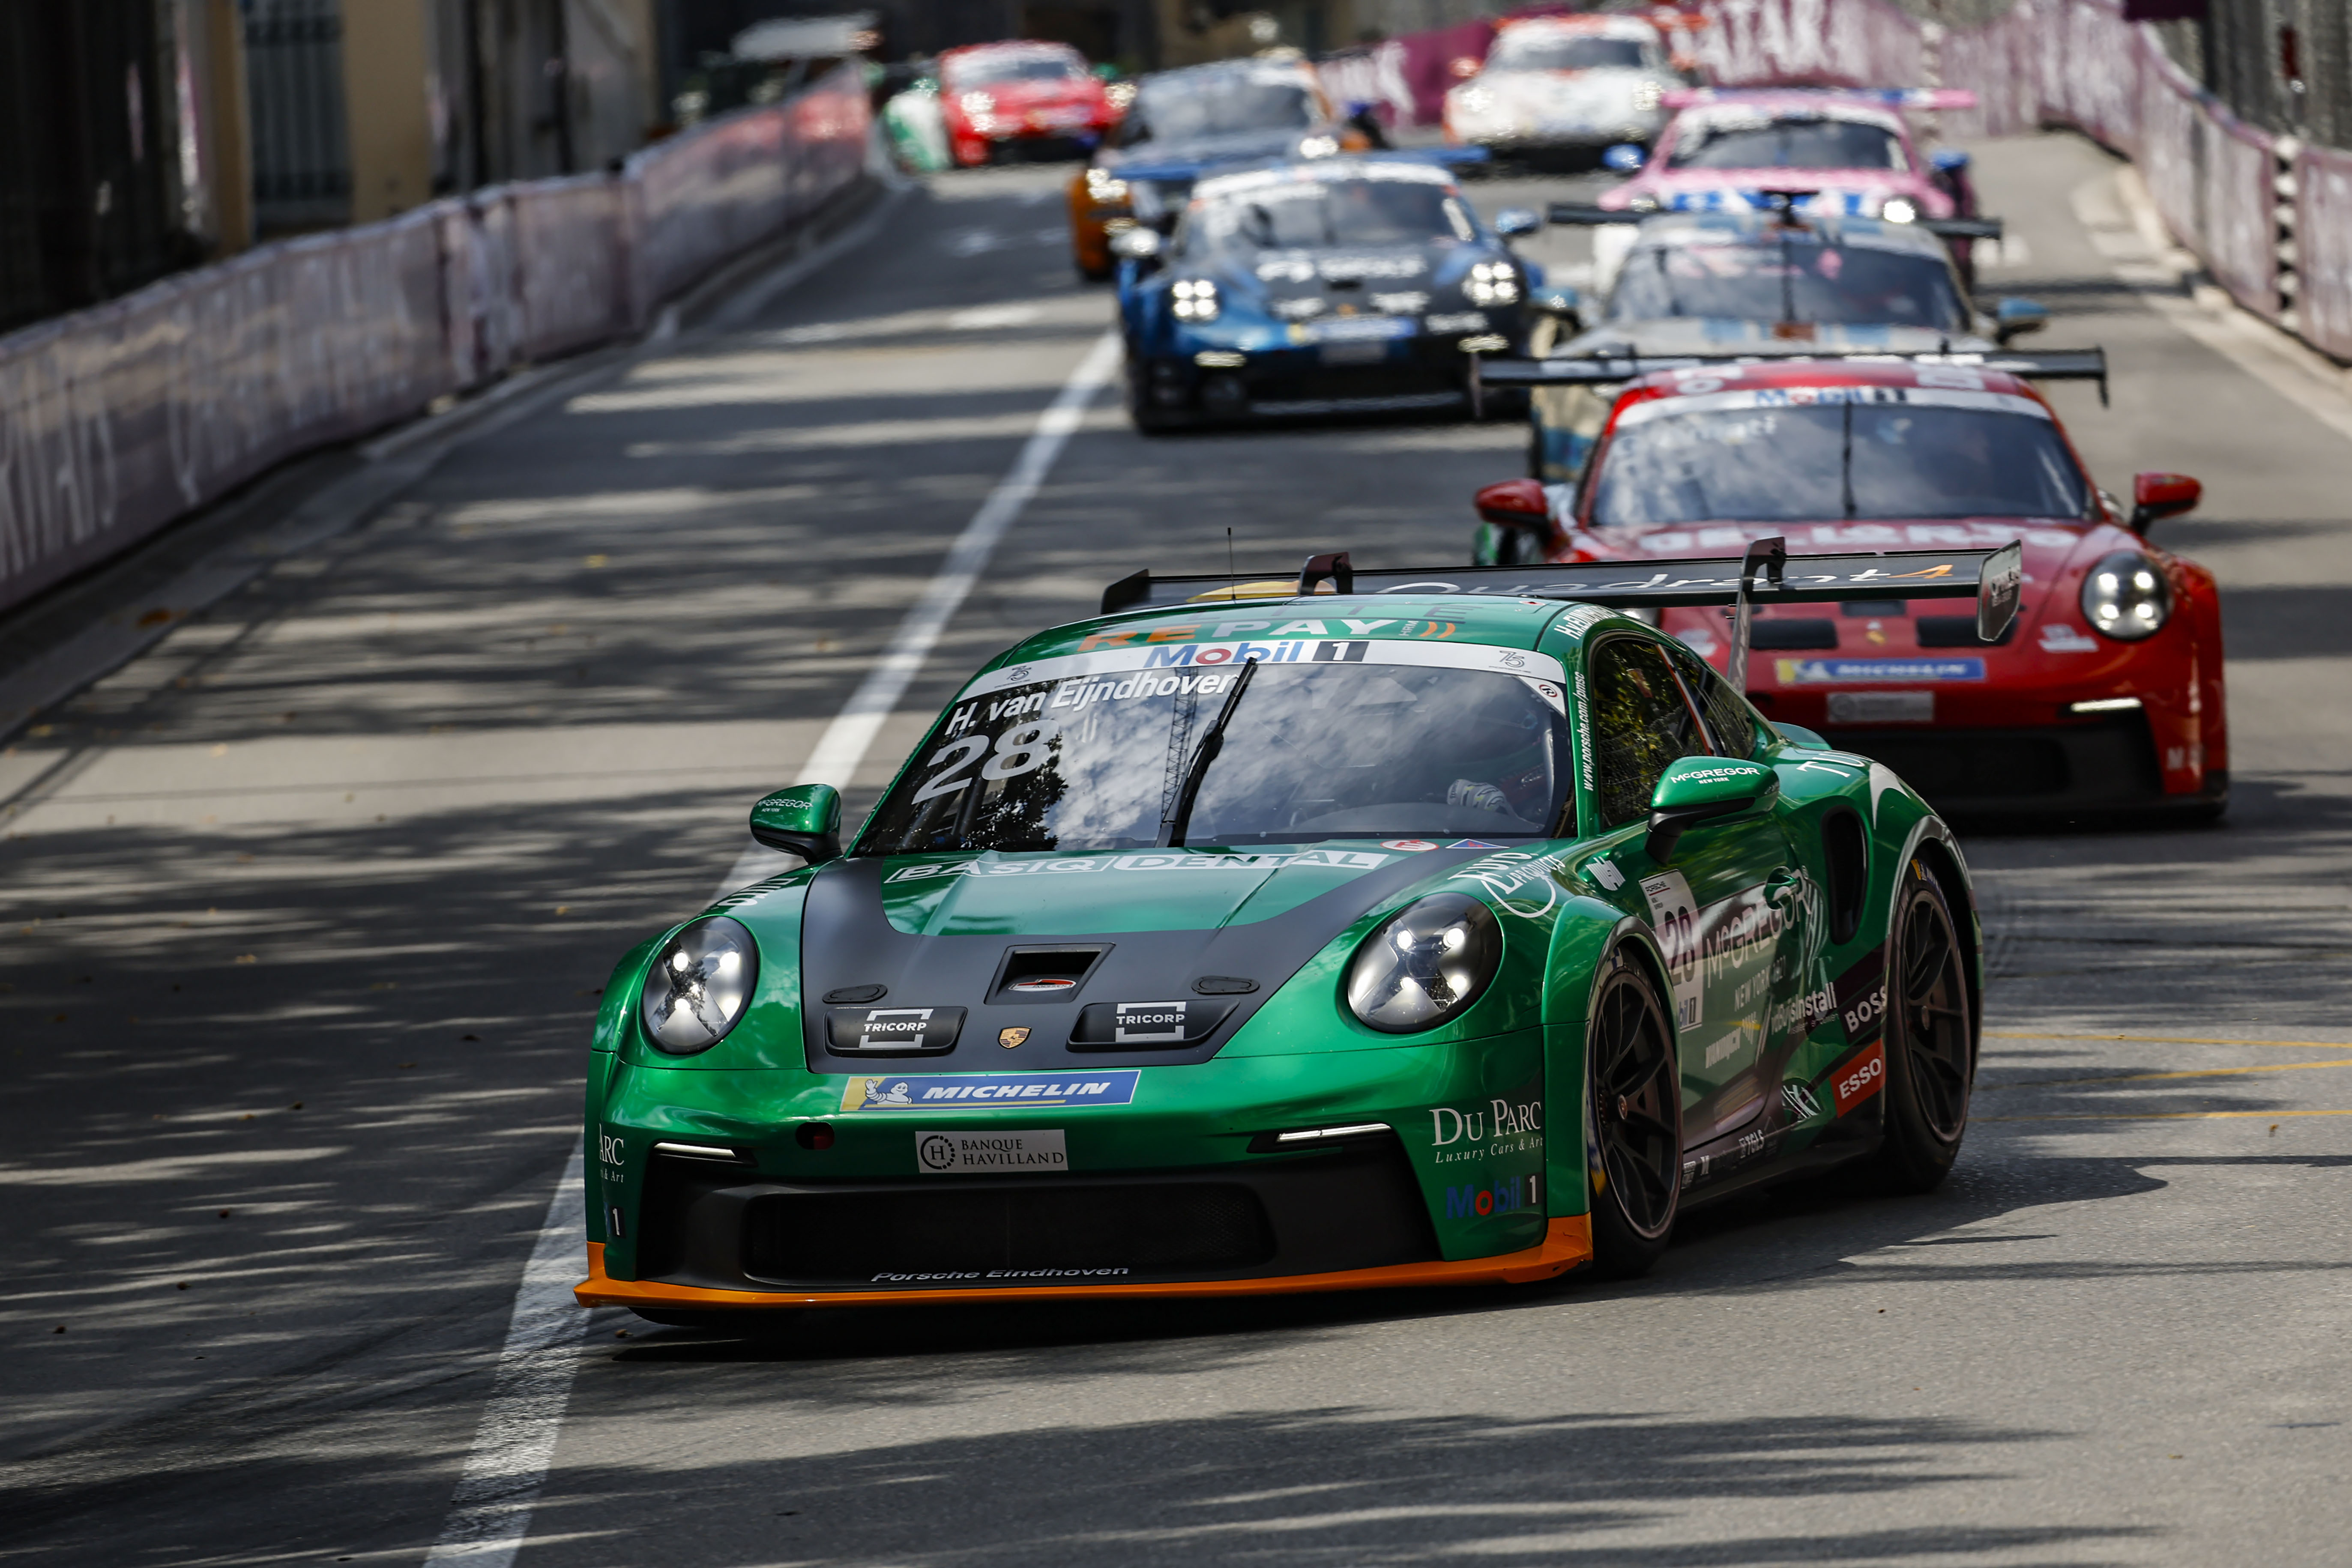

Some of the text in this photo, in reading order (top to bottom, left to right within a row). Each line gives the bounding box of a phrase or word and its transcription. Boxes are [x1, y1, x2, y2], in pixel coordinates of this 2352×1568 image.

[1143, 640, 1352, 669] Mobil 1
[944, 707, 976, 735] H.
[989, 690, 1046, 722] van
[911, 719, 1060, 805] 28
[898, 851, 1377, 879] BASIQ DENTAL
[1664, 906, 1695, 987] 28
[864, 1021, 927, 1033] TRICORP
[1116, 1013, 1185, 1025] TRICORP
[922, 1082, 1112, 1099] MICHELIN
[1839, 1058, 1882, 1099] ESSO
[599, 1123, 624, 1165] ARC
[929, 1145, 946, 1160] H
[961, 1139, 1023, 1152] BANQUE
[1435, 1148, 1485, 1164] Luxury
[1491, 1142, 1514, 1157] Cars
[1519, 1138, 1525, 1151] &
[963, 1152, 1064, 1165] HAVILLAND
[610, 1171, 624, 1183] Art
[1445, 1175, 1537, 1219] Mobil 1
[612, 1208, 620, 1236] 1
[871, 1267, 1129, 1281] Porsche Eindhoven
